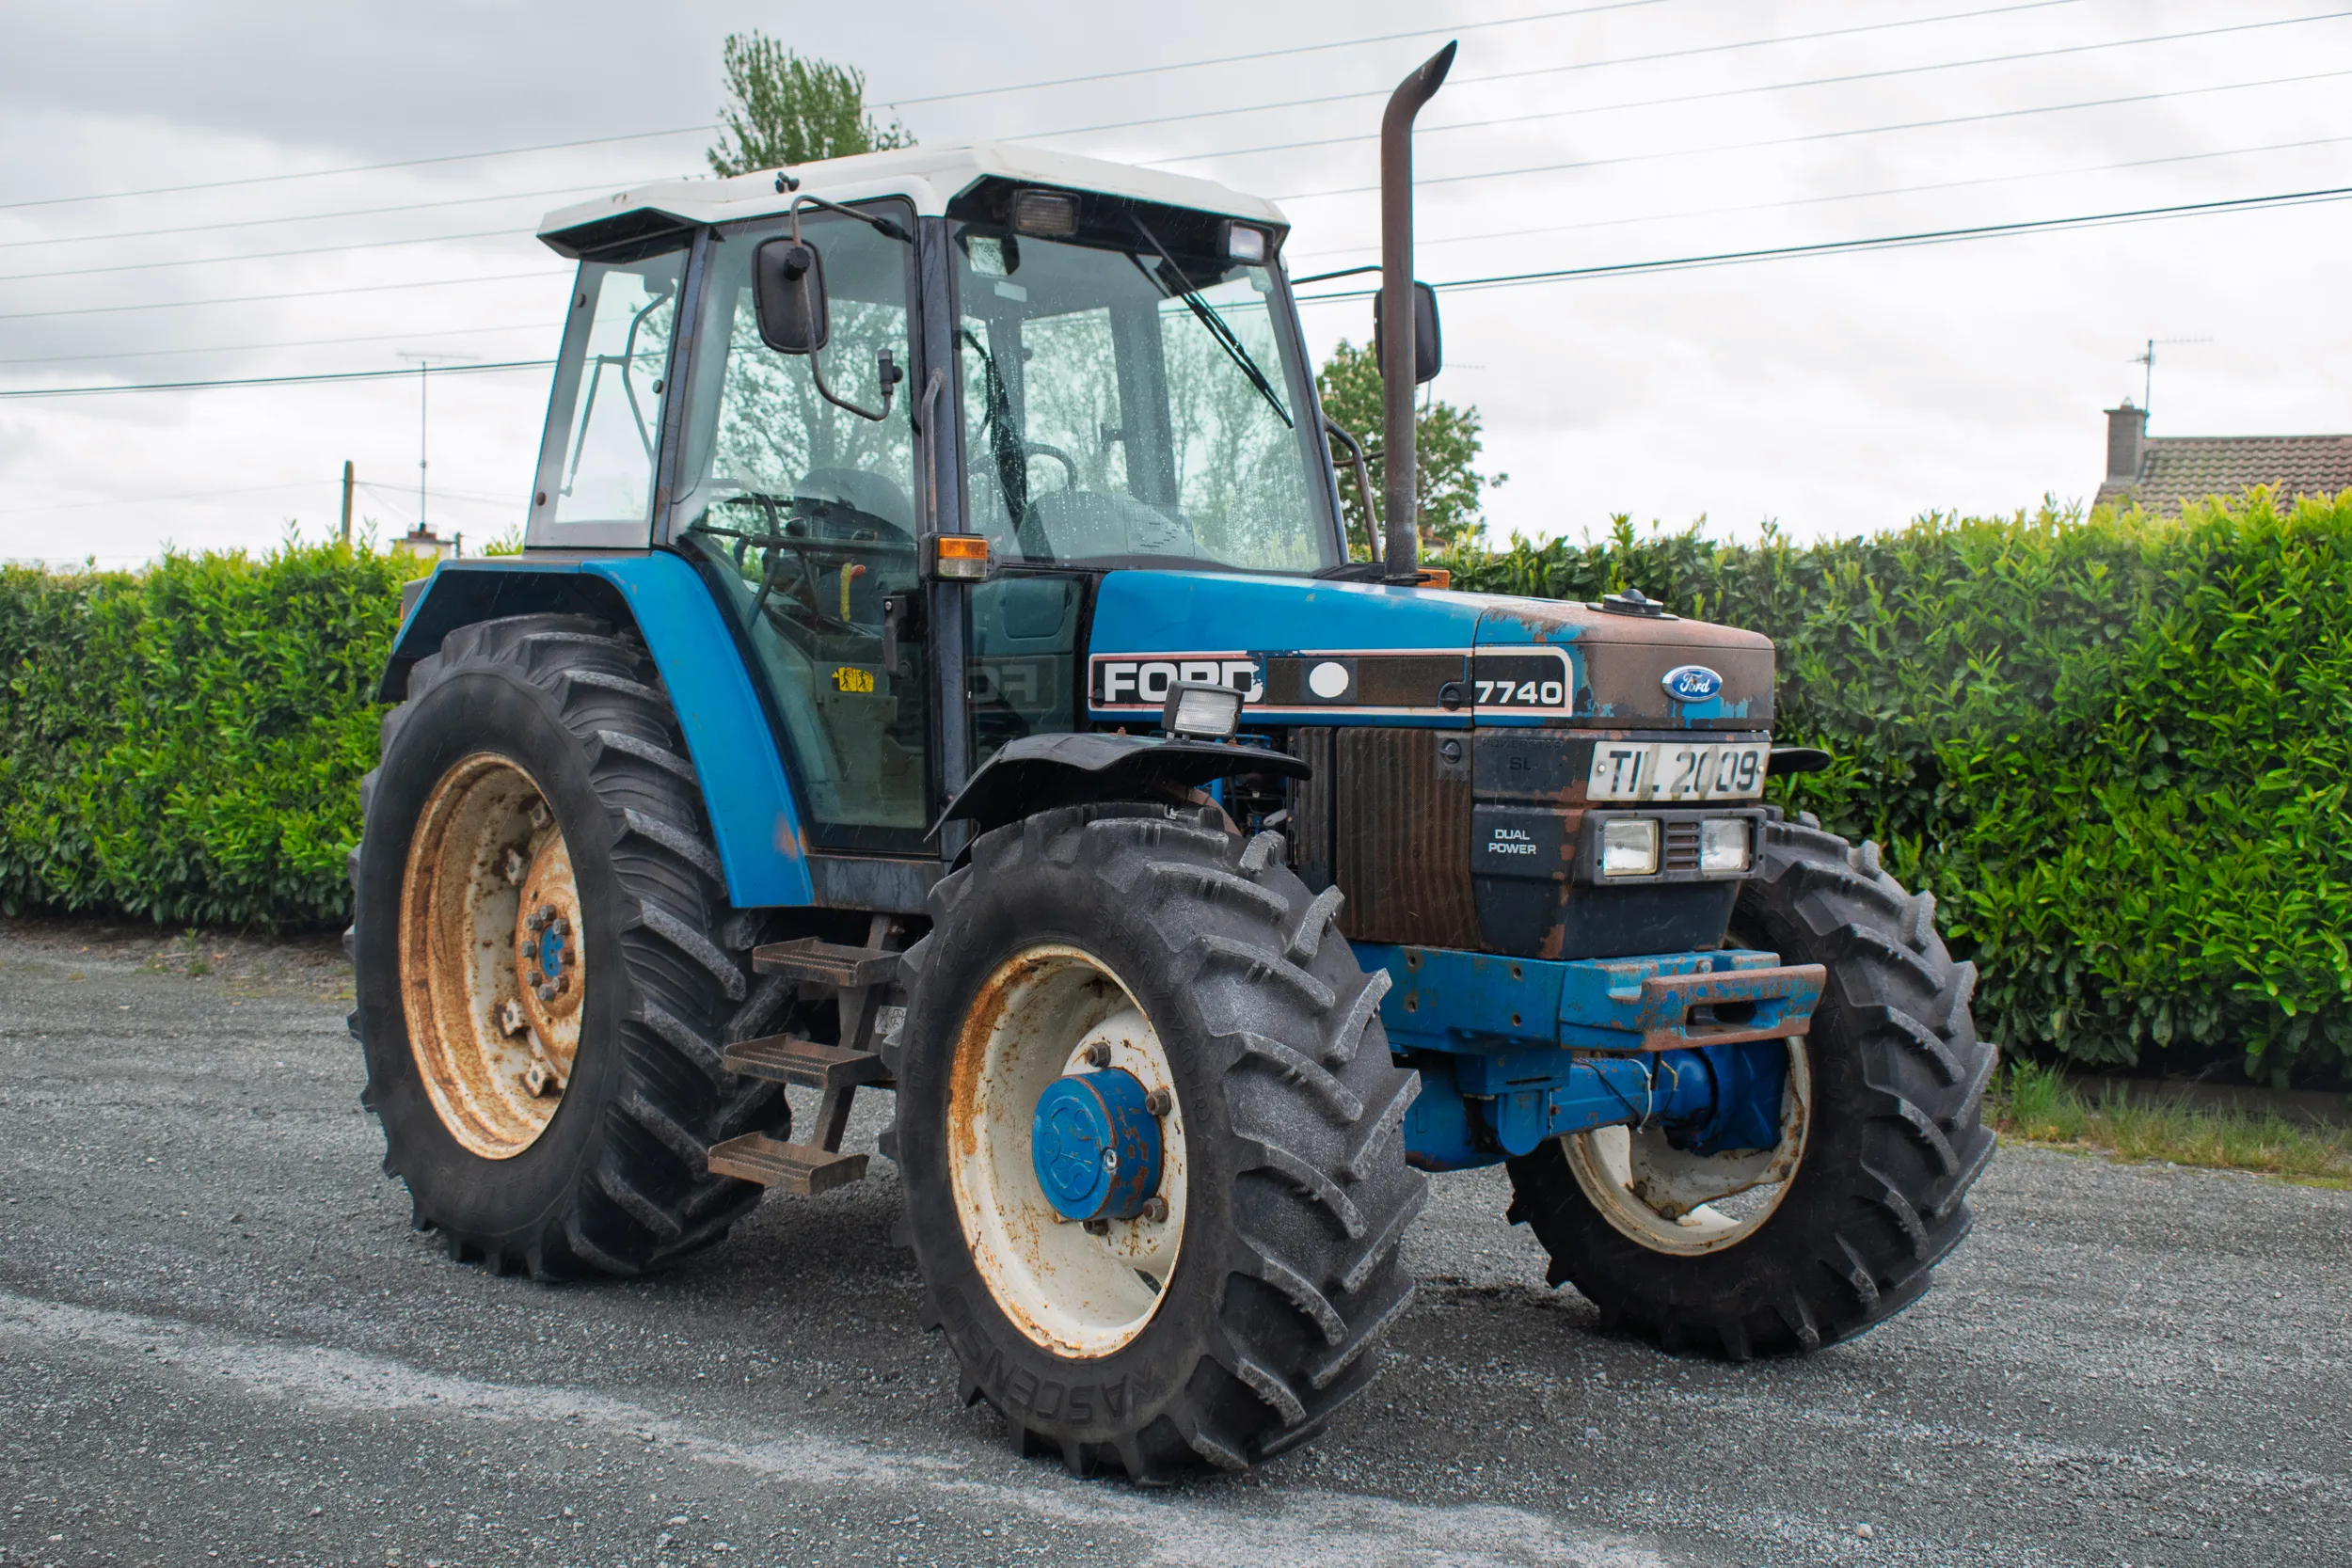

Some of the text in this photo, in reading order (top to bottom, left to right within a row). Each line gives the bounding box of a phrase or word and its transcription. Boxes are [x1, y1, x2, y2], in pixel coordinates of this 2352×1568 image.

[1678, 671, 1711, 694] Ford
[1474, 680, 1564, 705] 7740
[1494, 829, 1531, 841] DUAL
[1487, 842, 1537, 855] POWER
